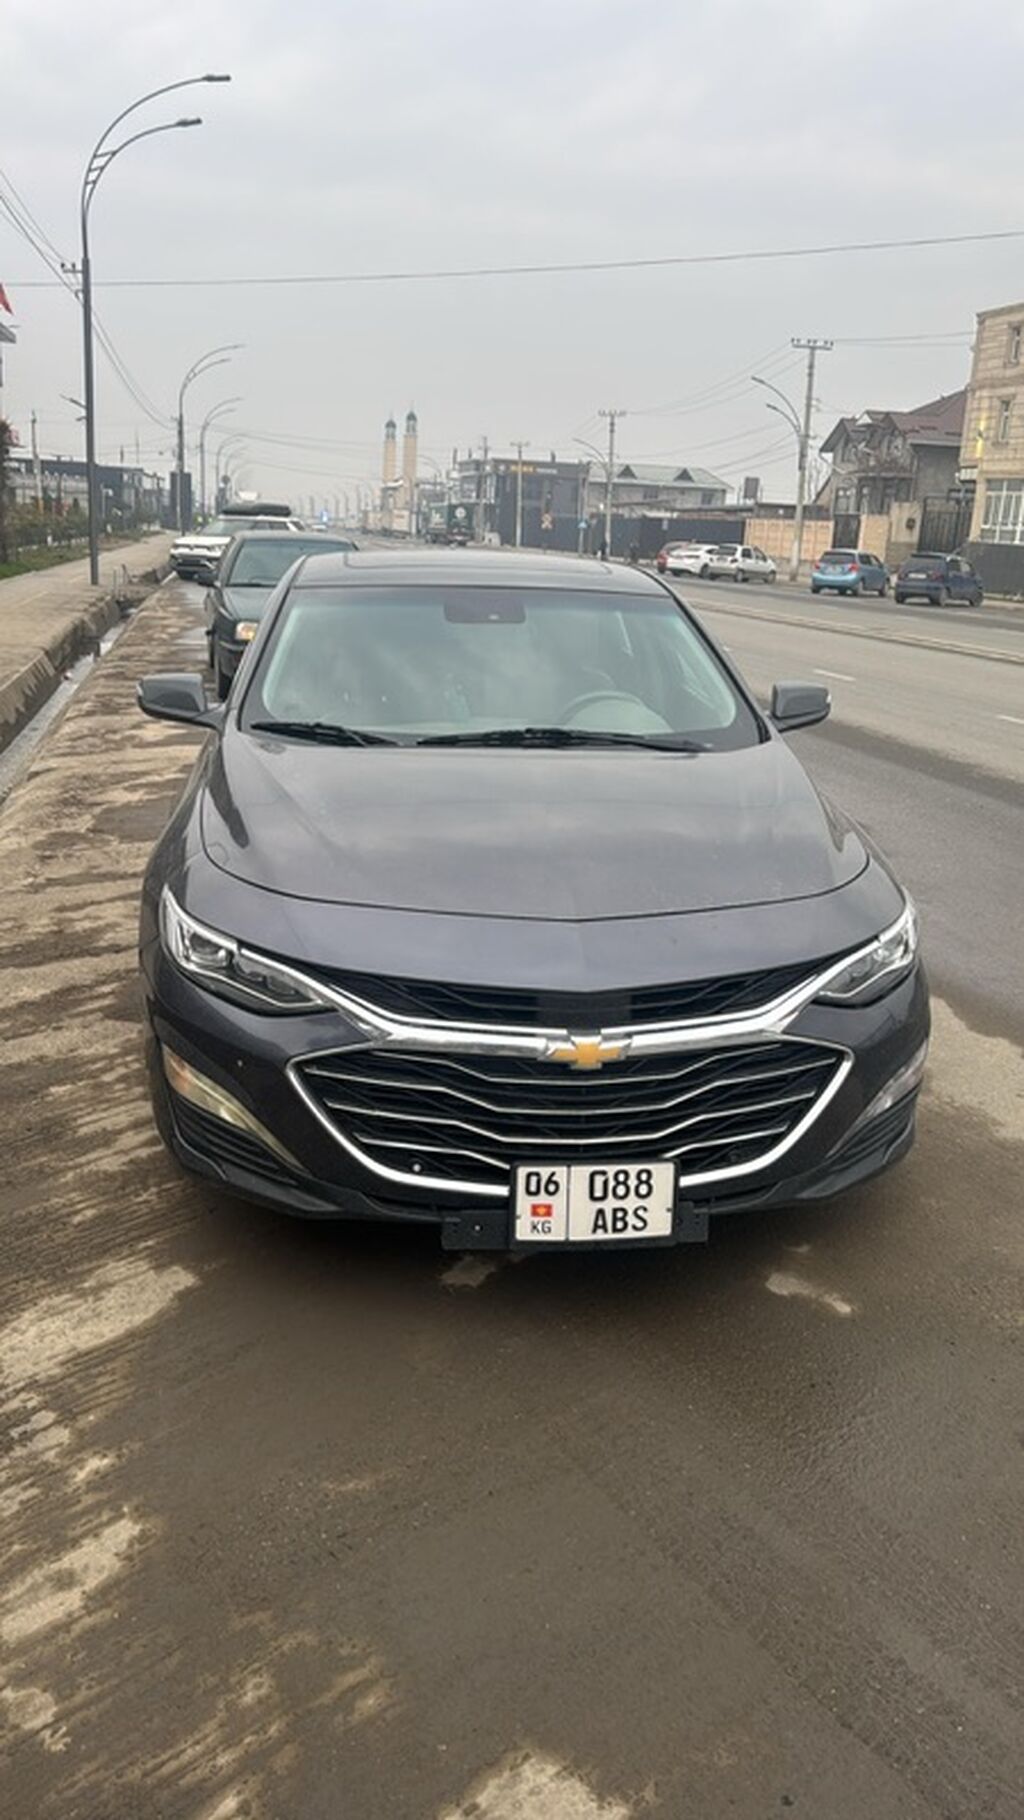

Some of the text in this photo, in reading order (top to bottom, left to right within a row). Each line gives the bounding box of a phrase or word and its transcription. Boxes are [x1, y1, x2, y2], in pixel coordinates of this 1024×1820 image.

[525, 1171, 560, 1197] 06
[589, 1169, 653, 1202] 088
[530, 1220, 552, 1234] KG
[591, 1205, 649, 1235] ABS
